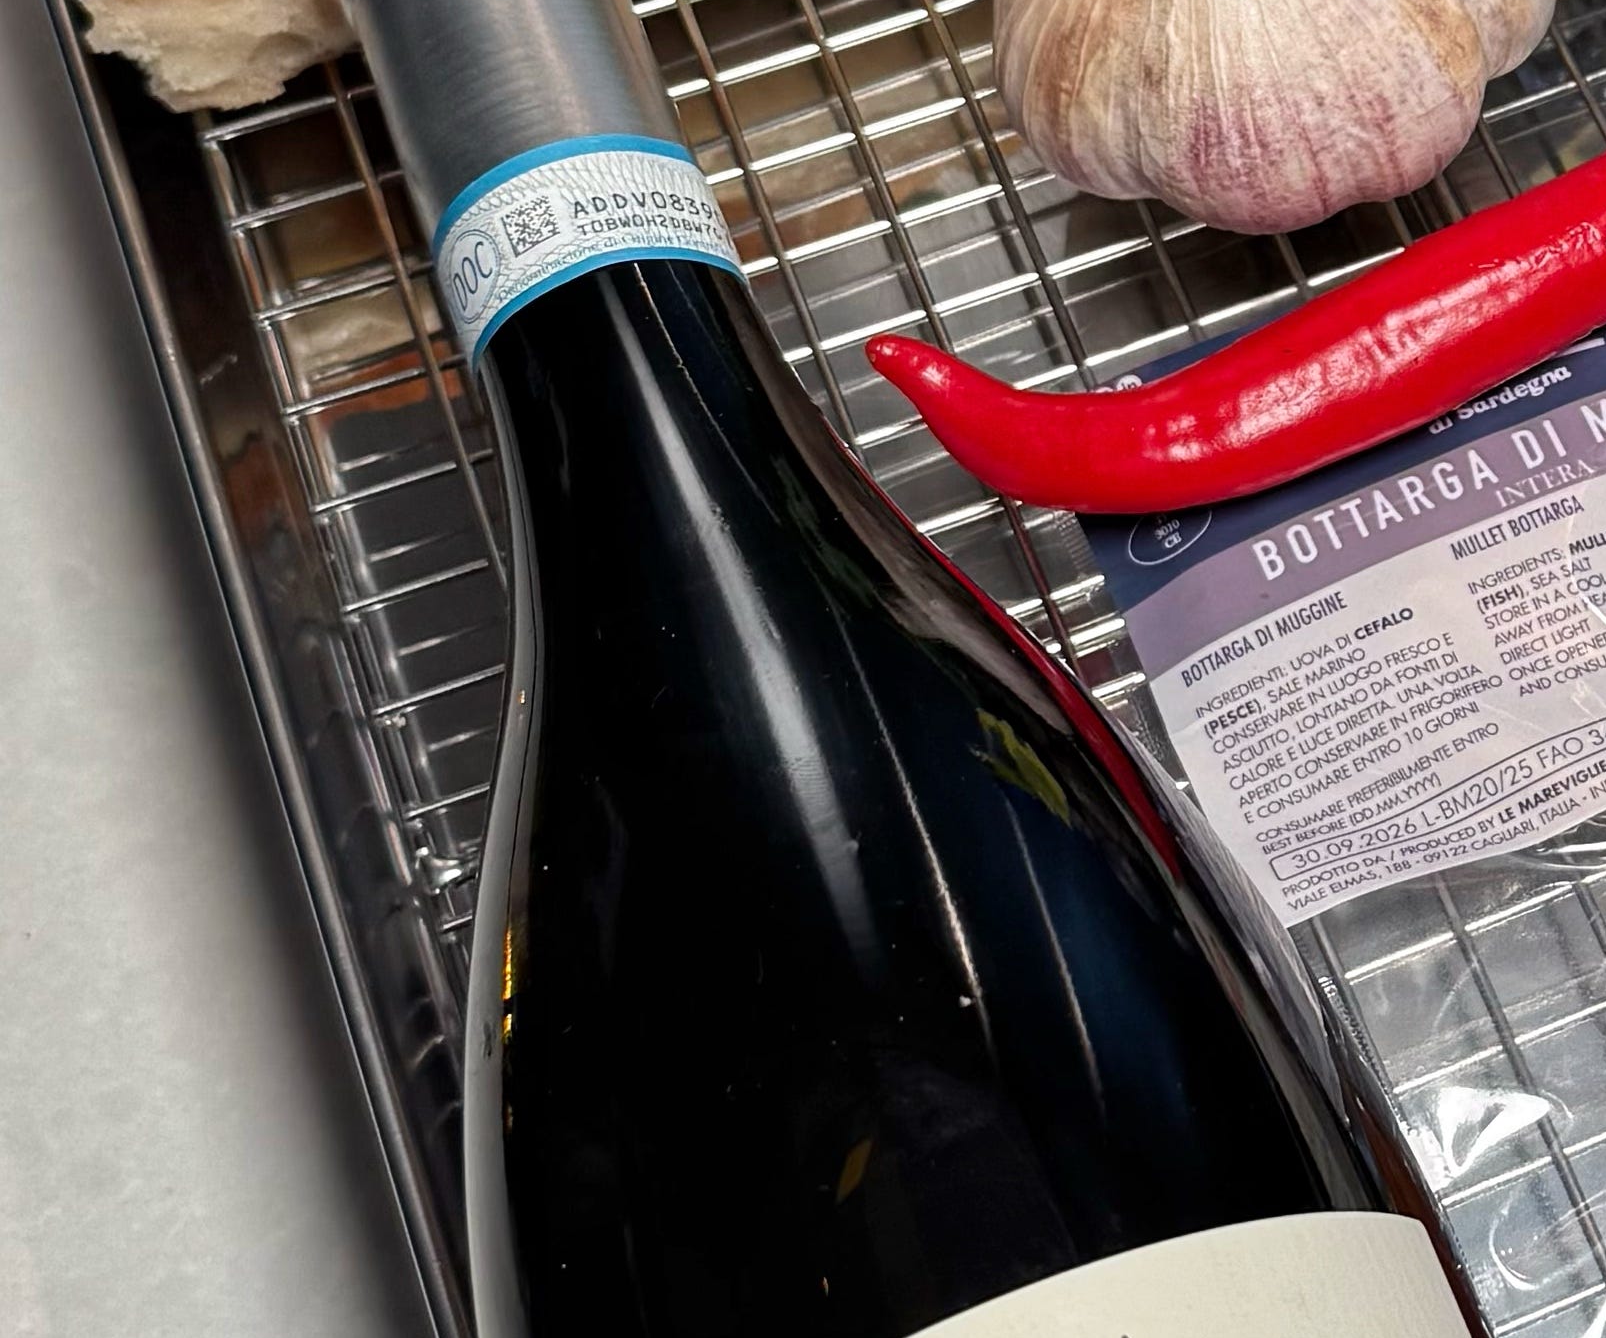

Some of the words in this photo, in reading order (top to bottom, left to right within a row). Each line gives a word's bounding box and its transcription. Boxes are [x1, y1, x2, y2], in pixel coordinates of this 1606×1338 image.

[452, 241, 493, 312] DOC
[1453, 361, 1574, 424] Sardegna
[1249, 445, 1500, 582] BOTTARGA
[1508, 418, 1569, 471] DI
[1493, 455, 1596, 509] INTERA
[1448, 523, 1510, 561] MULLET
[1506, 493, 1585, 538] BOTTARGA
[1466, 545, 1567, 596] INGREDIENTS:
[1474, 581, 1530, 616] (FISH),
[1528, 568, 1561, 591] SEA
[1558, 555, 1594, 579] SALT
[1179, 633, 1256, 688] BOTTARGA
[1253, 623, 1276, 647] DI
[1272, 590, 1349, 638] MUGGINE
[1481, 600, 1532, 631] STORE
[1530, 593, 1552, 611] IN
[1489, 619, 1537, 649] AWAY
[1535, 600, 1582, 630] FROM
[1498, 634, 1551, 666] DIRECT
[1193, 663, 1290, 719] INGREDIENTI:
[1288, 640, 1336, 673] UOVA
[1334, 632, 1354, 650] DI
[1351, 605, 1416, 643] CEFALO
[1201, 695, 1268, 740] (PESCE),
[1265, 676, 1304, 705] SALE
[1301, 645, 1368, 687] MARINO
[1209, 696, 1308, 756] CONSERVARE
[1306, 686, 1328, 706] IN
[1325, 658, 1385, 696] LUOGO
[1382, 636, 1443, 669] FRESCO
[1506, 654, 1555, 684] ONCE
[1515, 674, 1554, 700] AND
[1218, 725, 1297, 774] ASCIUTTO,
[1294, 687, 1370, 734] LONTANO
[1369, 675, 1396, 696] DA
[1394, 655, 1441, 685] FONTI
[1440, 649, 1460, 666] DI
[1227, 752, 1287, 792] CALORE
[1297, 726, 1336, 756] LUCE
[1396, 679, 1435, 706] UNA
[1432, 660, 1482, 689] VOLTA
[1235, 770, 1295, 809] APERTO
[1292, 720, 1390, 781] CONSERVARE
[1388, 711, 1409, 730] IN
[1407, 671, 1505, 721] FRIGORIFERO
[1254, 763, 1353, 820] CONSUMARE
[1351, 736, 1404, 772] ENTRO
[1402, 724, 1425, 746] 10
[1422, 699, 1480, 736] GIORNI
[1254, 798, 1347, 845] CONSUMARE
[1451, 719, 1501, 754] ENTRO
[1289, 815, 1419, 870] 30.09.2026
[1419, 756, 1536, 828] L-BM20/25
[1534, 733, 1587, 770] FAO
[1280, 859, 1361, 898] PRODOTTO
[1360, 850, 1387, 867] DA
[1398, 822, 1478, 857] PRODUCED
[1475, 813, 1499, 833] BY
[1496, 805, 1517, 824] LE
[1287, 886, 1329, 912] VIALE
[1328, 867, 1384, 894] ELMAS,
